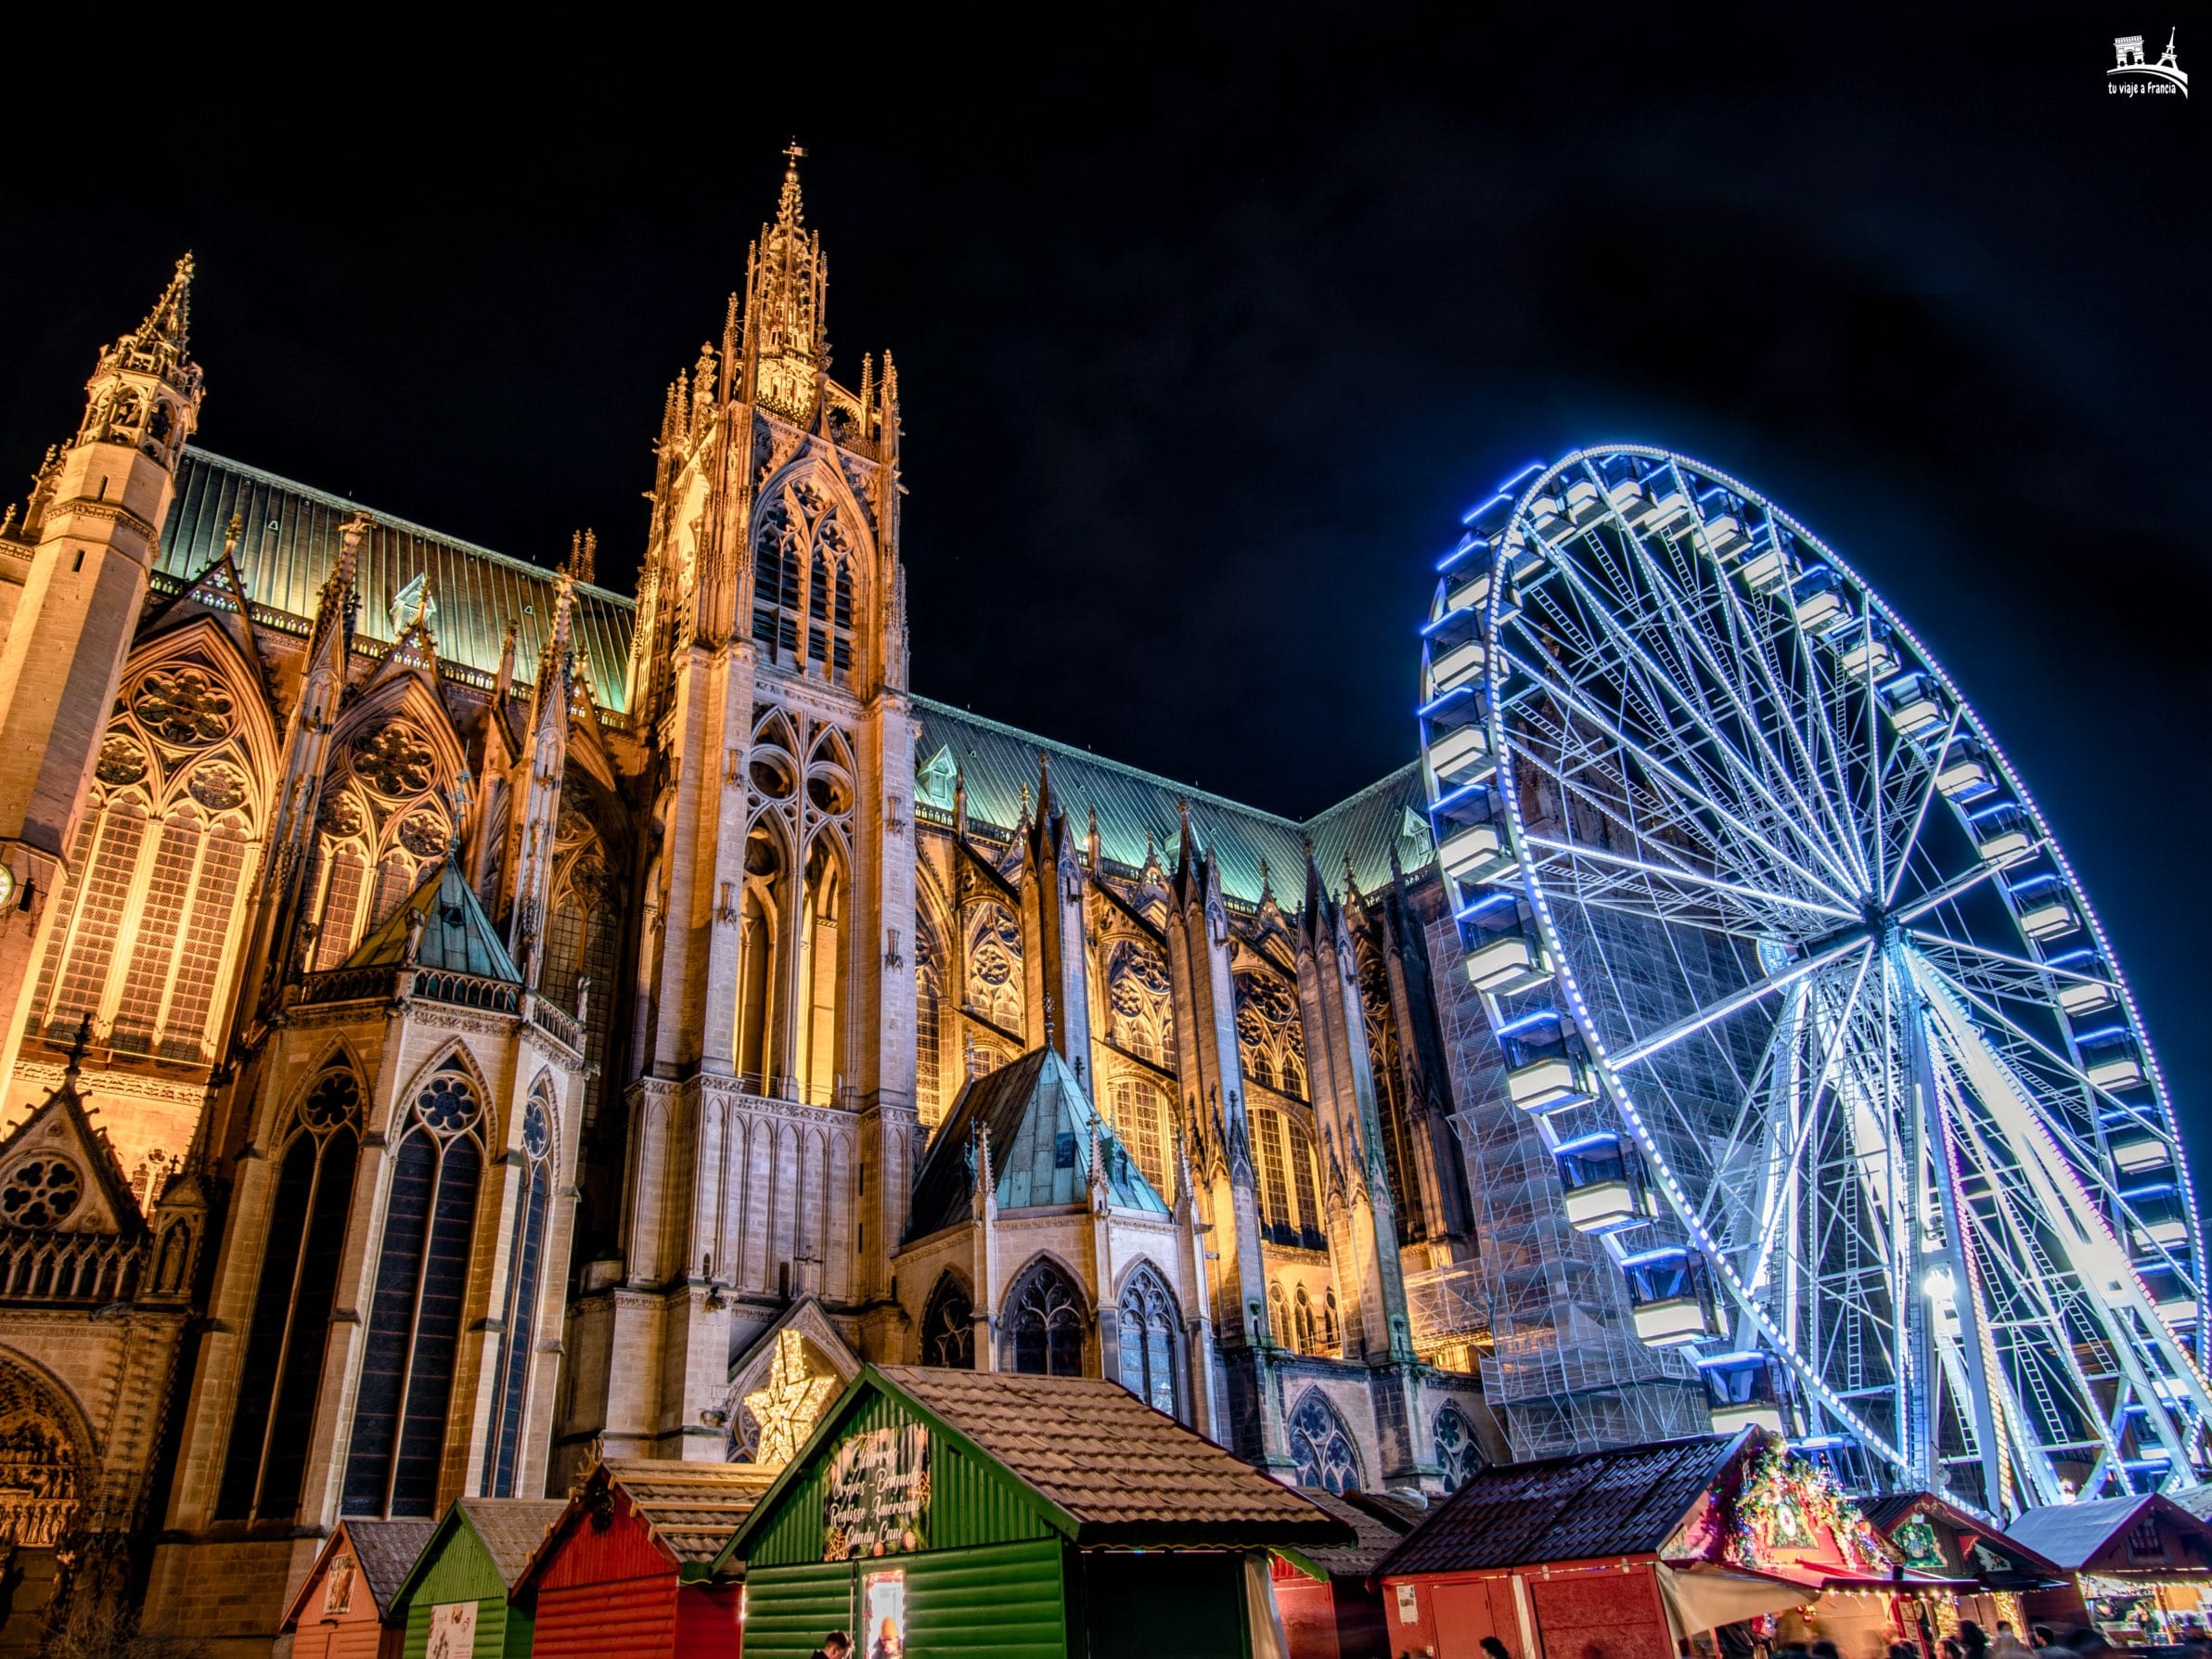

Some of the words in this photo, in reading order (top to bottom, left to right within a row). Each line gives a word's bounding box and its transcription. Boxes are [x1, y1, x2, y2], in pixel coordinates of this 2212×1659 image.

[851, 1447, 899, 1473] Churros
[845, 1525, 876, 1549] Candy
[879, 1522, 904, 1543] Cane
